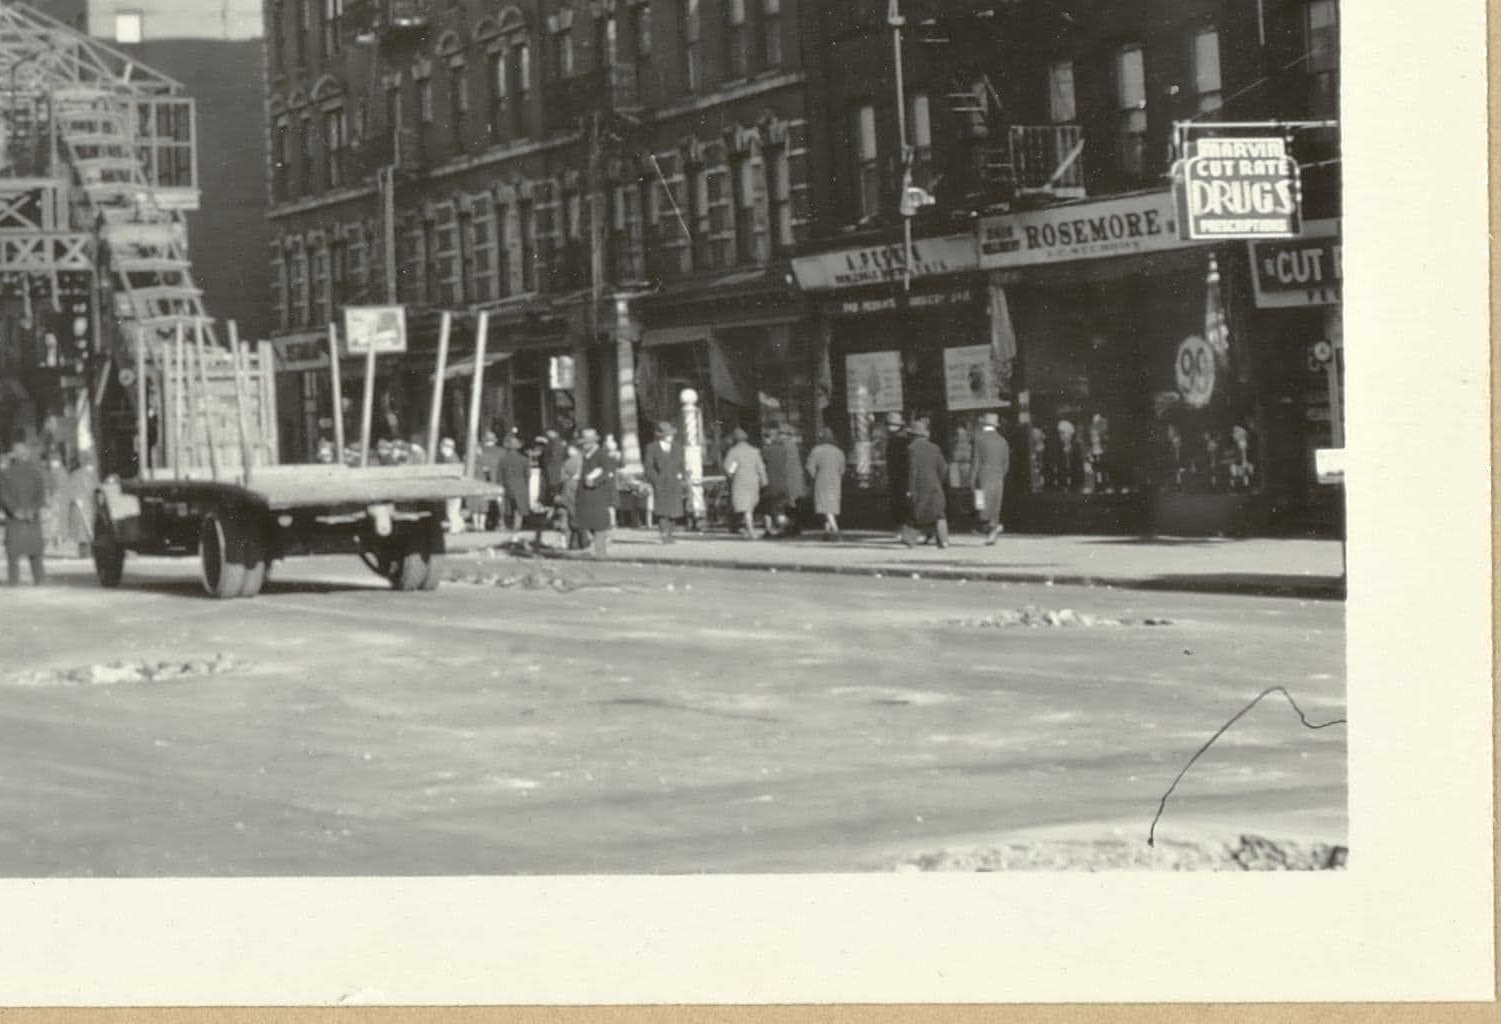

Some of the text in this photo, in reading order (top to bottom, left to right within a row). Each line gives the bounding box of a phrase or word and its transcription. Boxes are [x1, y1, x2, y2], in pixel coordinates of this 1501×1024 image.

[1200, 142, 1283, 158] MARVIN
[1196, 159, 1289, 176] CUT RATE
[1191, 179, 1296, 216] DRUGS
[1025, 209, 1162, 250] ROSEMORE
